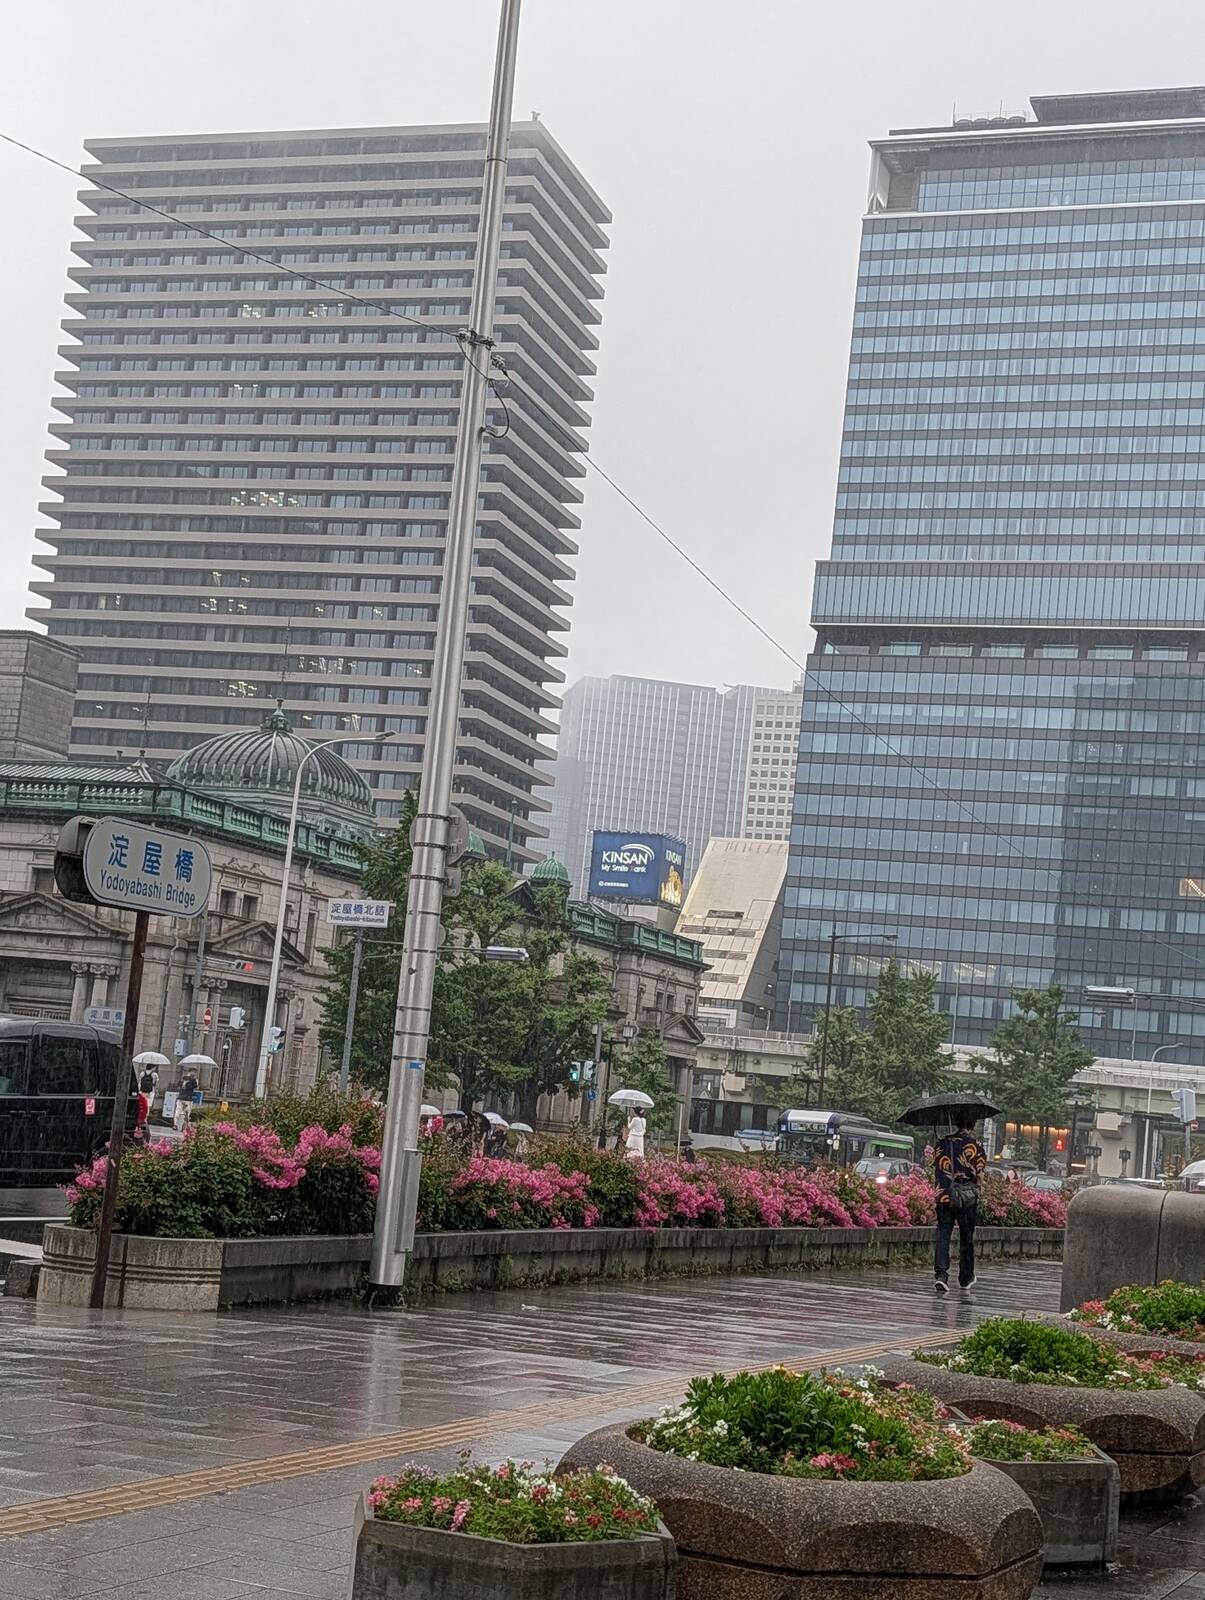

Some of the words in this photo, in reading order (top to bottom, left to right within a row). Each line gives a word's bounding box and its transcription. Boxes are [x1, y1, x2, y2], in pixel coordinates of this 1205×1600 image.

[108, 834, 194, 883] 淀屋橋
[602, 851, 647, 865] KINSAN
[101, 869, 161, 898] Yodoyabashi
[166, 884, 195, 908] Bridge
